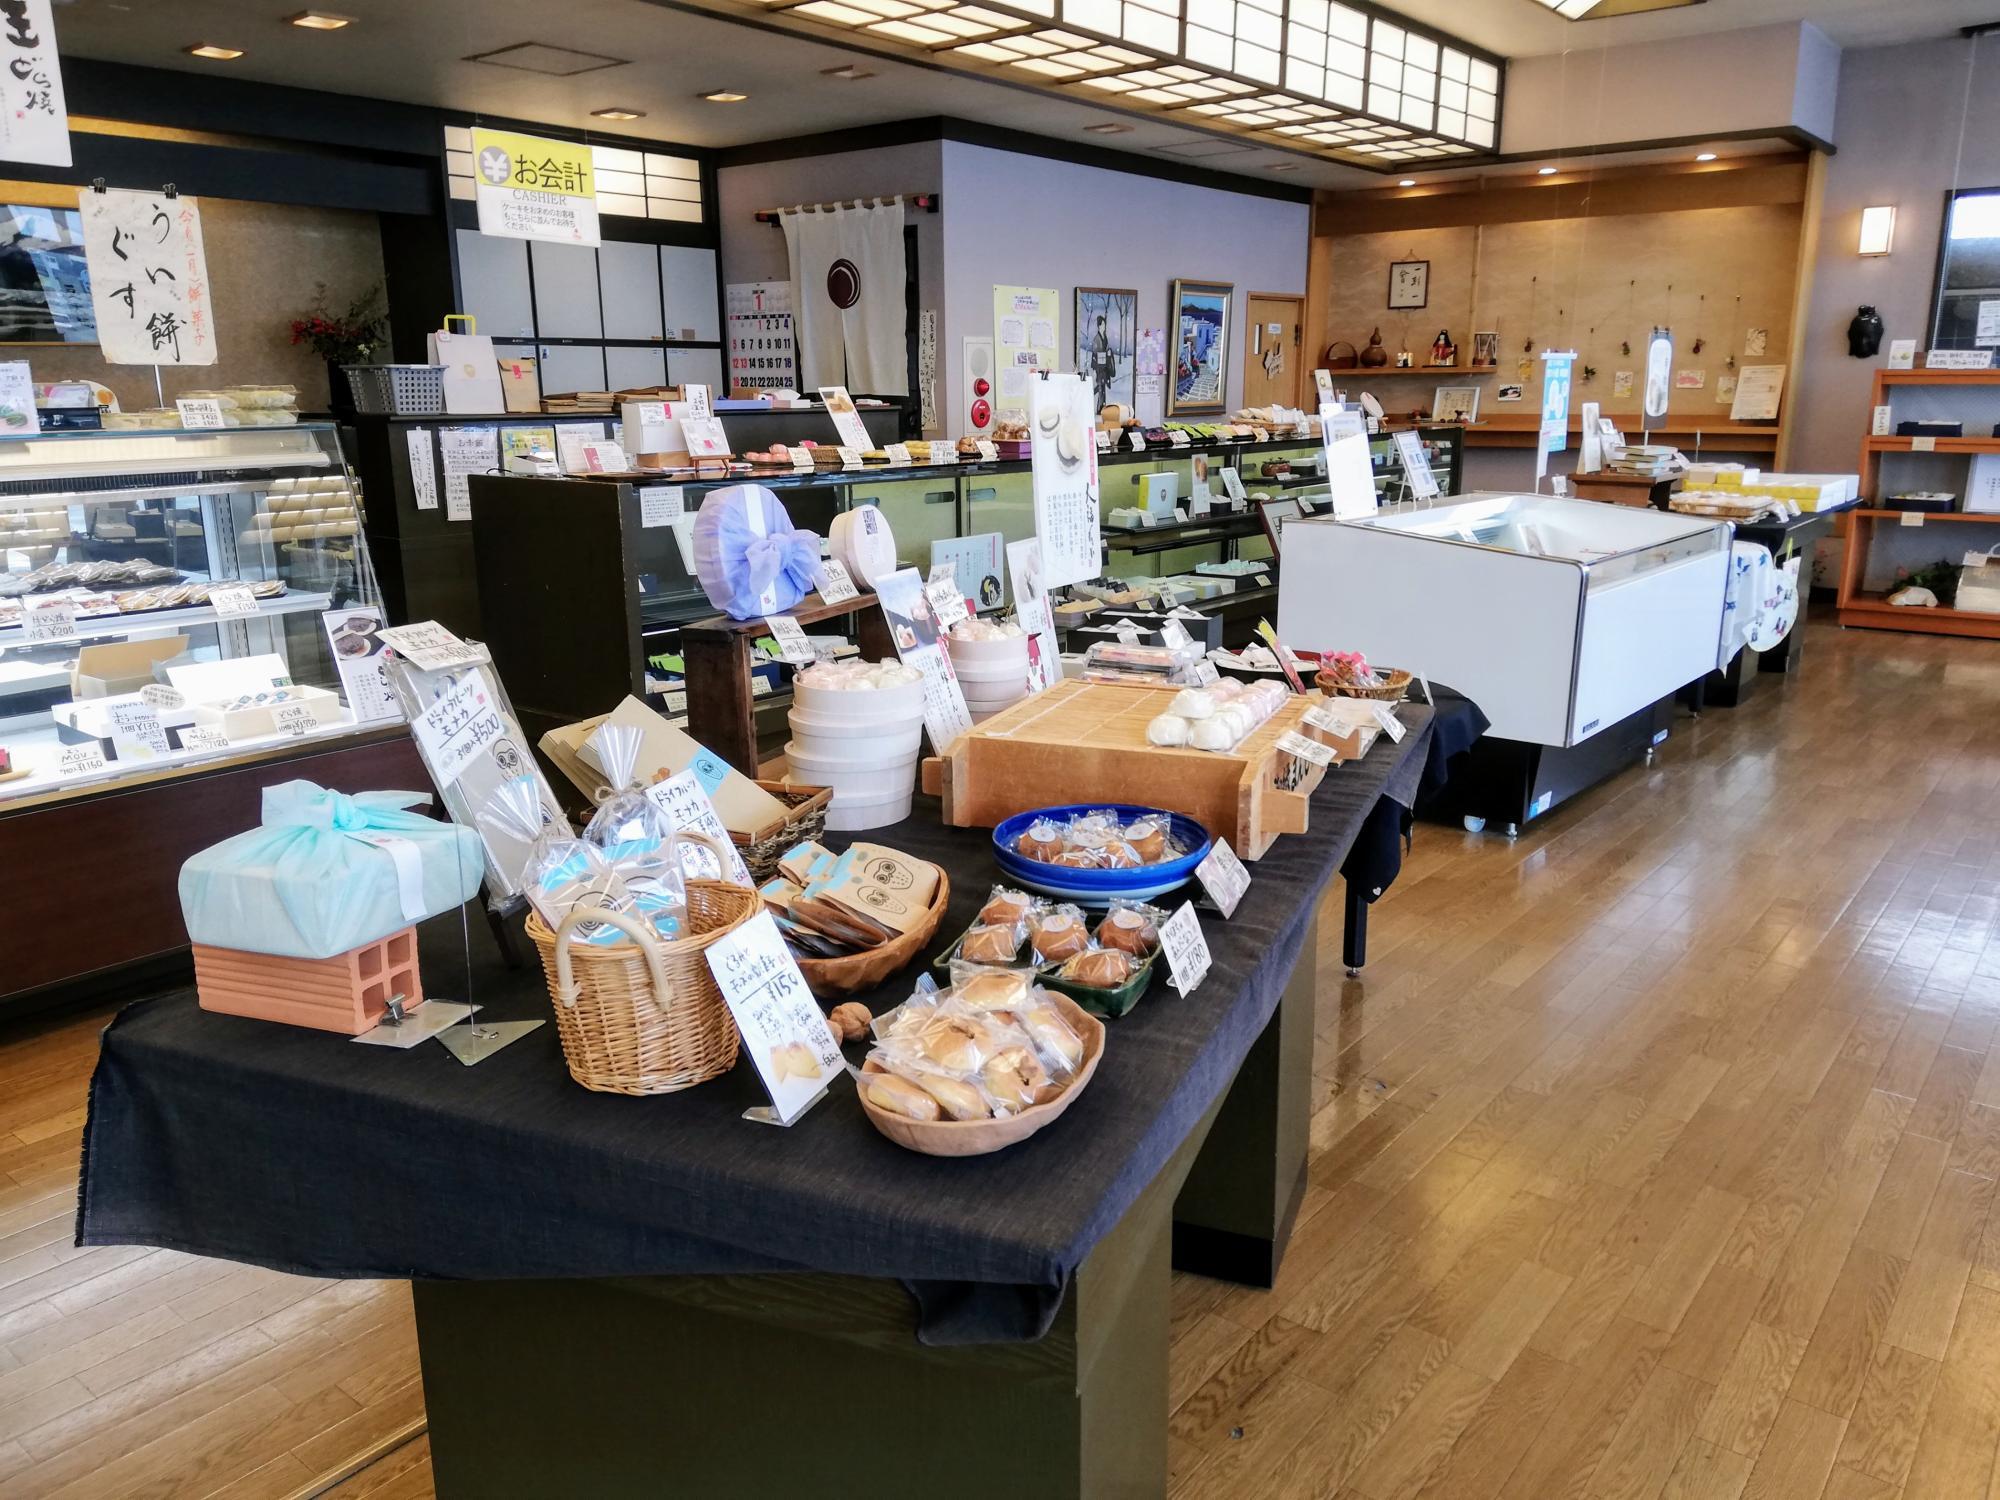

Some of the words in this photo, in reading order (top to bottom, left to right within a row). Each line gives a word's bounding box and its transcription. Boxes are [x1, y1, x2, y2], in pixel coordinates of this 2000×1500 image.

[515, 154, 587, 193] お会計
[513, 188, 567, 206] CASHIER
[758, 320, 762, 331] 1
[766, 320, 771, 331] 2
[775, 319, 780, 330] 3
[783, 319, 789, 330] 4
[732, 339, 737, 350] 5
[740, 339, 746, 350] 6
[749, 339, 754, 350] 7
[758, 339, 763, 349] 8
[766, 339, 772, 349] 9
[774, 339, 782, 349] 10
[783, 338, 791, 349] 11
[732, 358, 739, 369] 12
[740, 358, 748, 369] 13
[749, 358, 756, 369] 14
[757, 358, 765, 369] 15
[766, 358, 774, 369] 16
[775, 358, 782, 369] 17
[783, 358, 792, 369] 18
[732, 377, 740, 388] 19
[740, 377, 749, 388] 20
[749, 377, 757, 388] 21
[757, 377, 766, 388] 22
[766, 377, 775, 388] 23
[775, 377, 784, 388] 24
[784, 377, 793, 388] 25
[50, 625, 75, 638] ¥200
[427, 684, 473, 728] ドライフルーツ
[442, 709, 469, 737] モナカ
[469, 713, 499, 745] ¥500
[655, 779, 697, 808] ドライフルーツ
[674, 799, 700, 822] モナカ
[1186, 943, 1206, 973] ¥180
[766, 973, 799, 1002] ¥150
